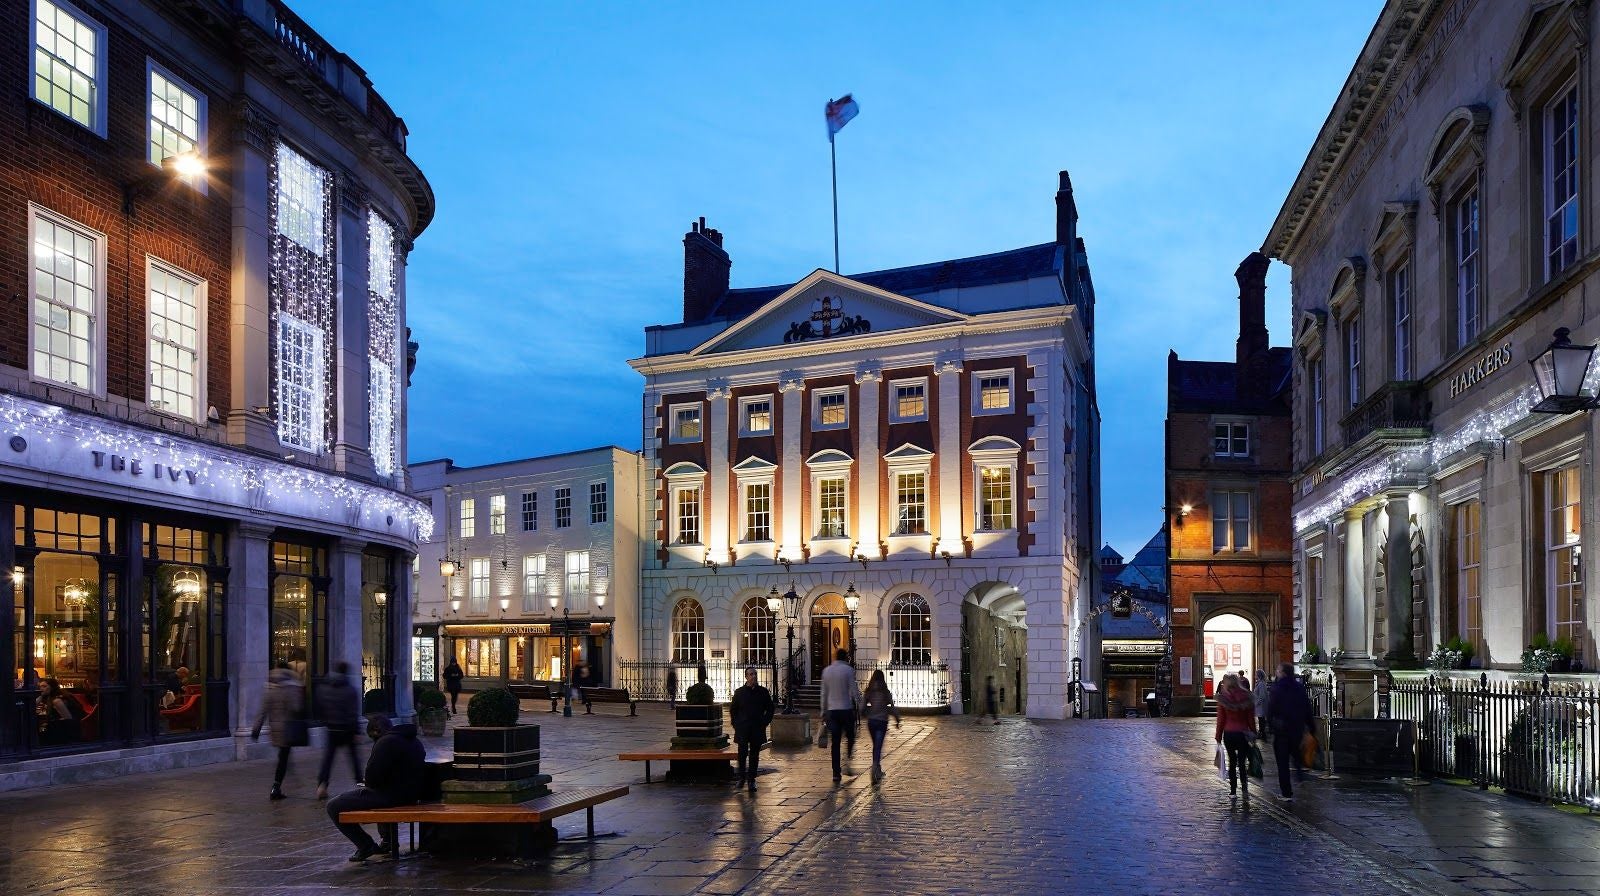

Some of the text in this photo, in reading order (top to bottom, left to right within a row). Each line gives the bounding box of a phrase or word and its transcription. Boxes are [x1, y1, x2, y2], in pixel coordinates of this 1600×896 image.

[1450, 342, 1511, 399] HARKERS
[91, 450, 200, 485] THE IVY
